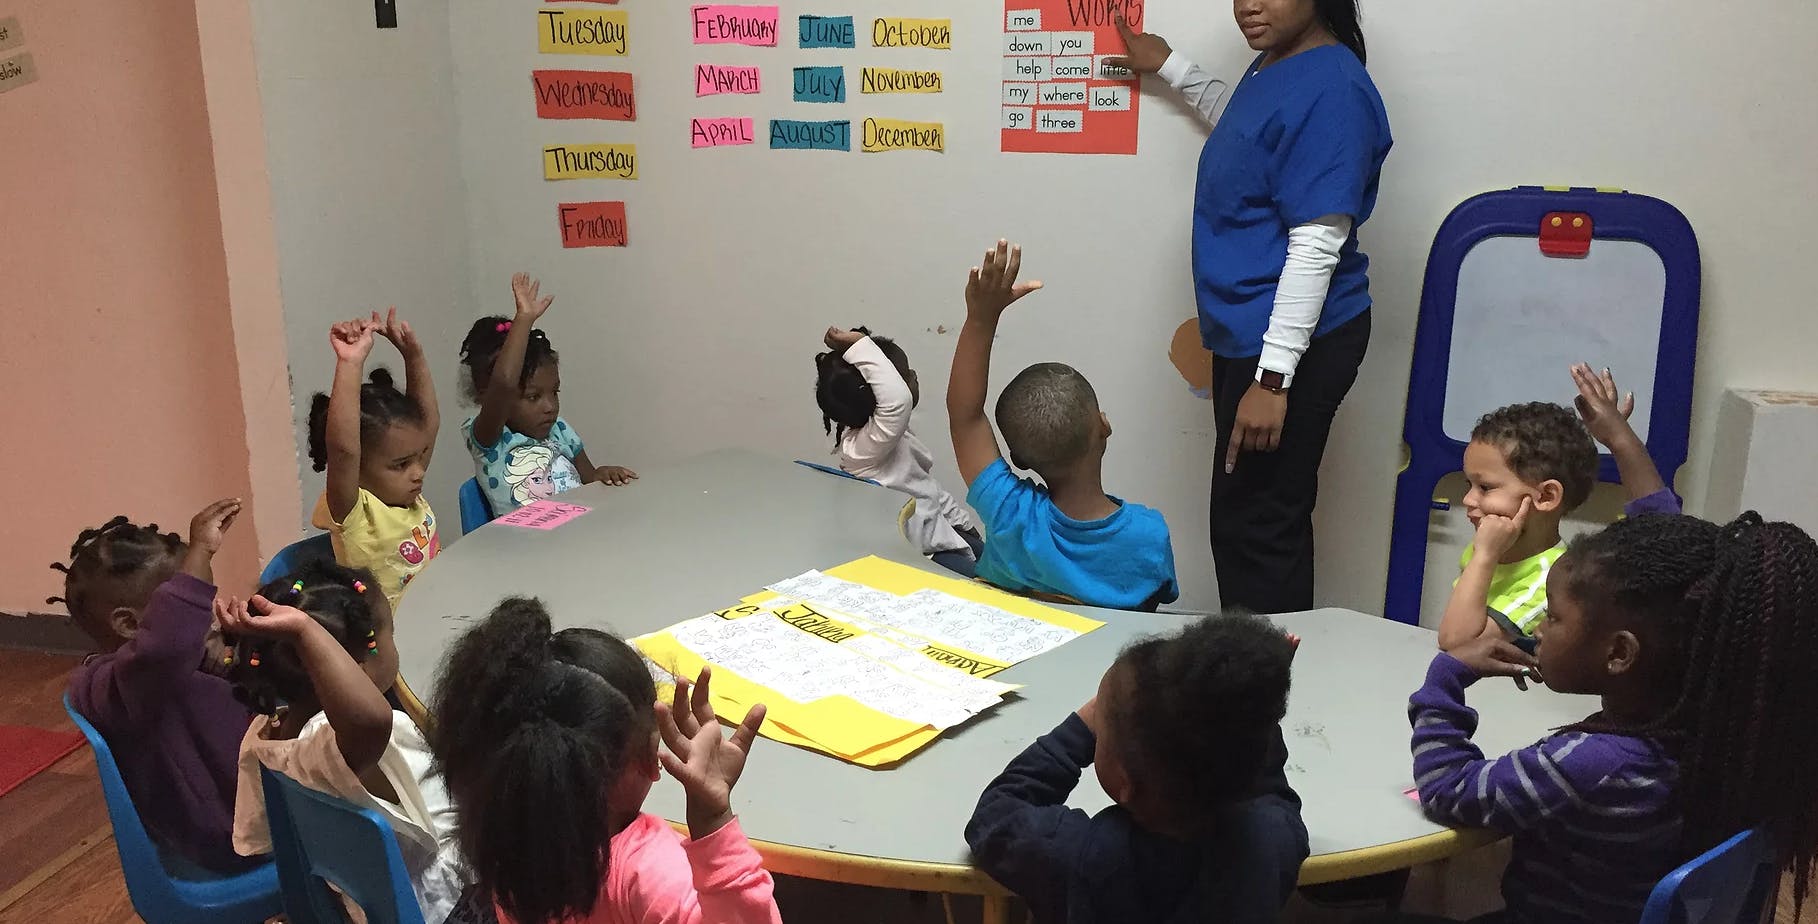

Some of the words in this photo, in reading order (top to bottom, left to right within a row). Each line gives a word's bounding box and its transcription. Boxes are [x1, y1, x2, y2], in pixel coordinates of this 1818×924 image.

[538, 10, 626, 54] Tuesday
[799, 16, 853, 45] JUNE
[873, 18, 950, 47] October
[1013, 17, 1034, 26] me
[1009, 36, 1043, 52] down
[1060, 39, 1082, 56] you
[696, 65, 758, 94] MARCH
[861, 67, 941, 92] November
[1016, 59, 1042, 80] help
[1055, 66, 1090, 76] come
[793, 67, 842, 101] JULY
[1009, 88, 1029, 103] my
[1044, 86, 1084, 101] where
[535, 78, 632, 118] Wednesday
[1095, 91, 1119, 106] look
[1009, 112, 1024, 127] go
[1041, 113, 1076, 128] three
[863, 118, 942, 148] December
[545, 147, 634, 178] Thursday
[562, 207, 624, 245] Friday
